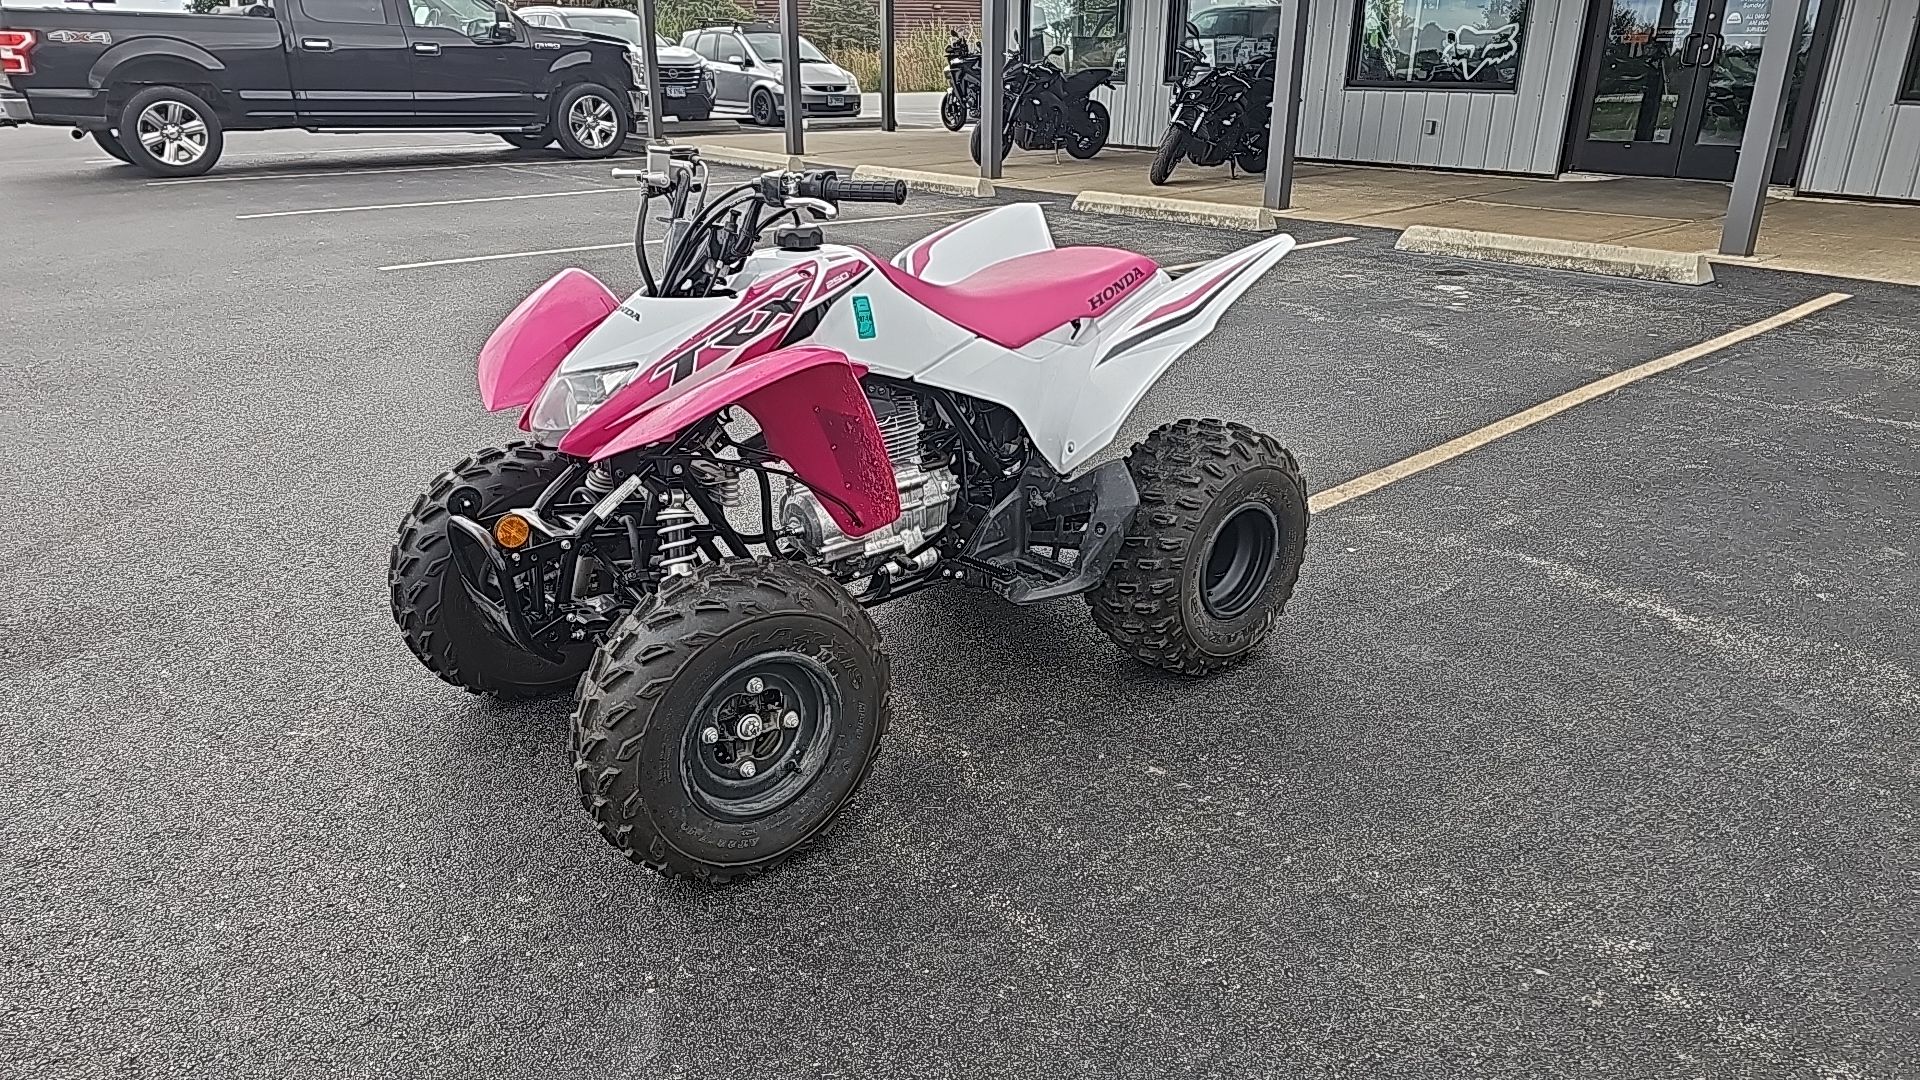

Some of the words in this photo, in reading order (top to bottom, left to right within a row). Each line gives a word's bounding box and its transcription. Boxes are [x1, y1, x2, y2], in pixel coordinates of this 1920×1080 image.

[1087, 266, 1146, 312] HONDA
[620, 304, 641, 323] NDA
[655, 284, 805, 388] TRX
